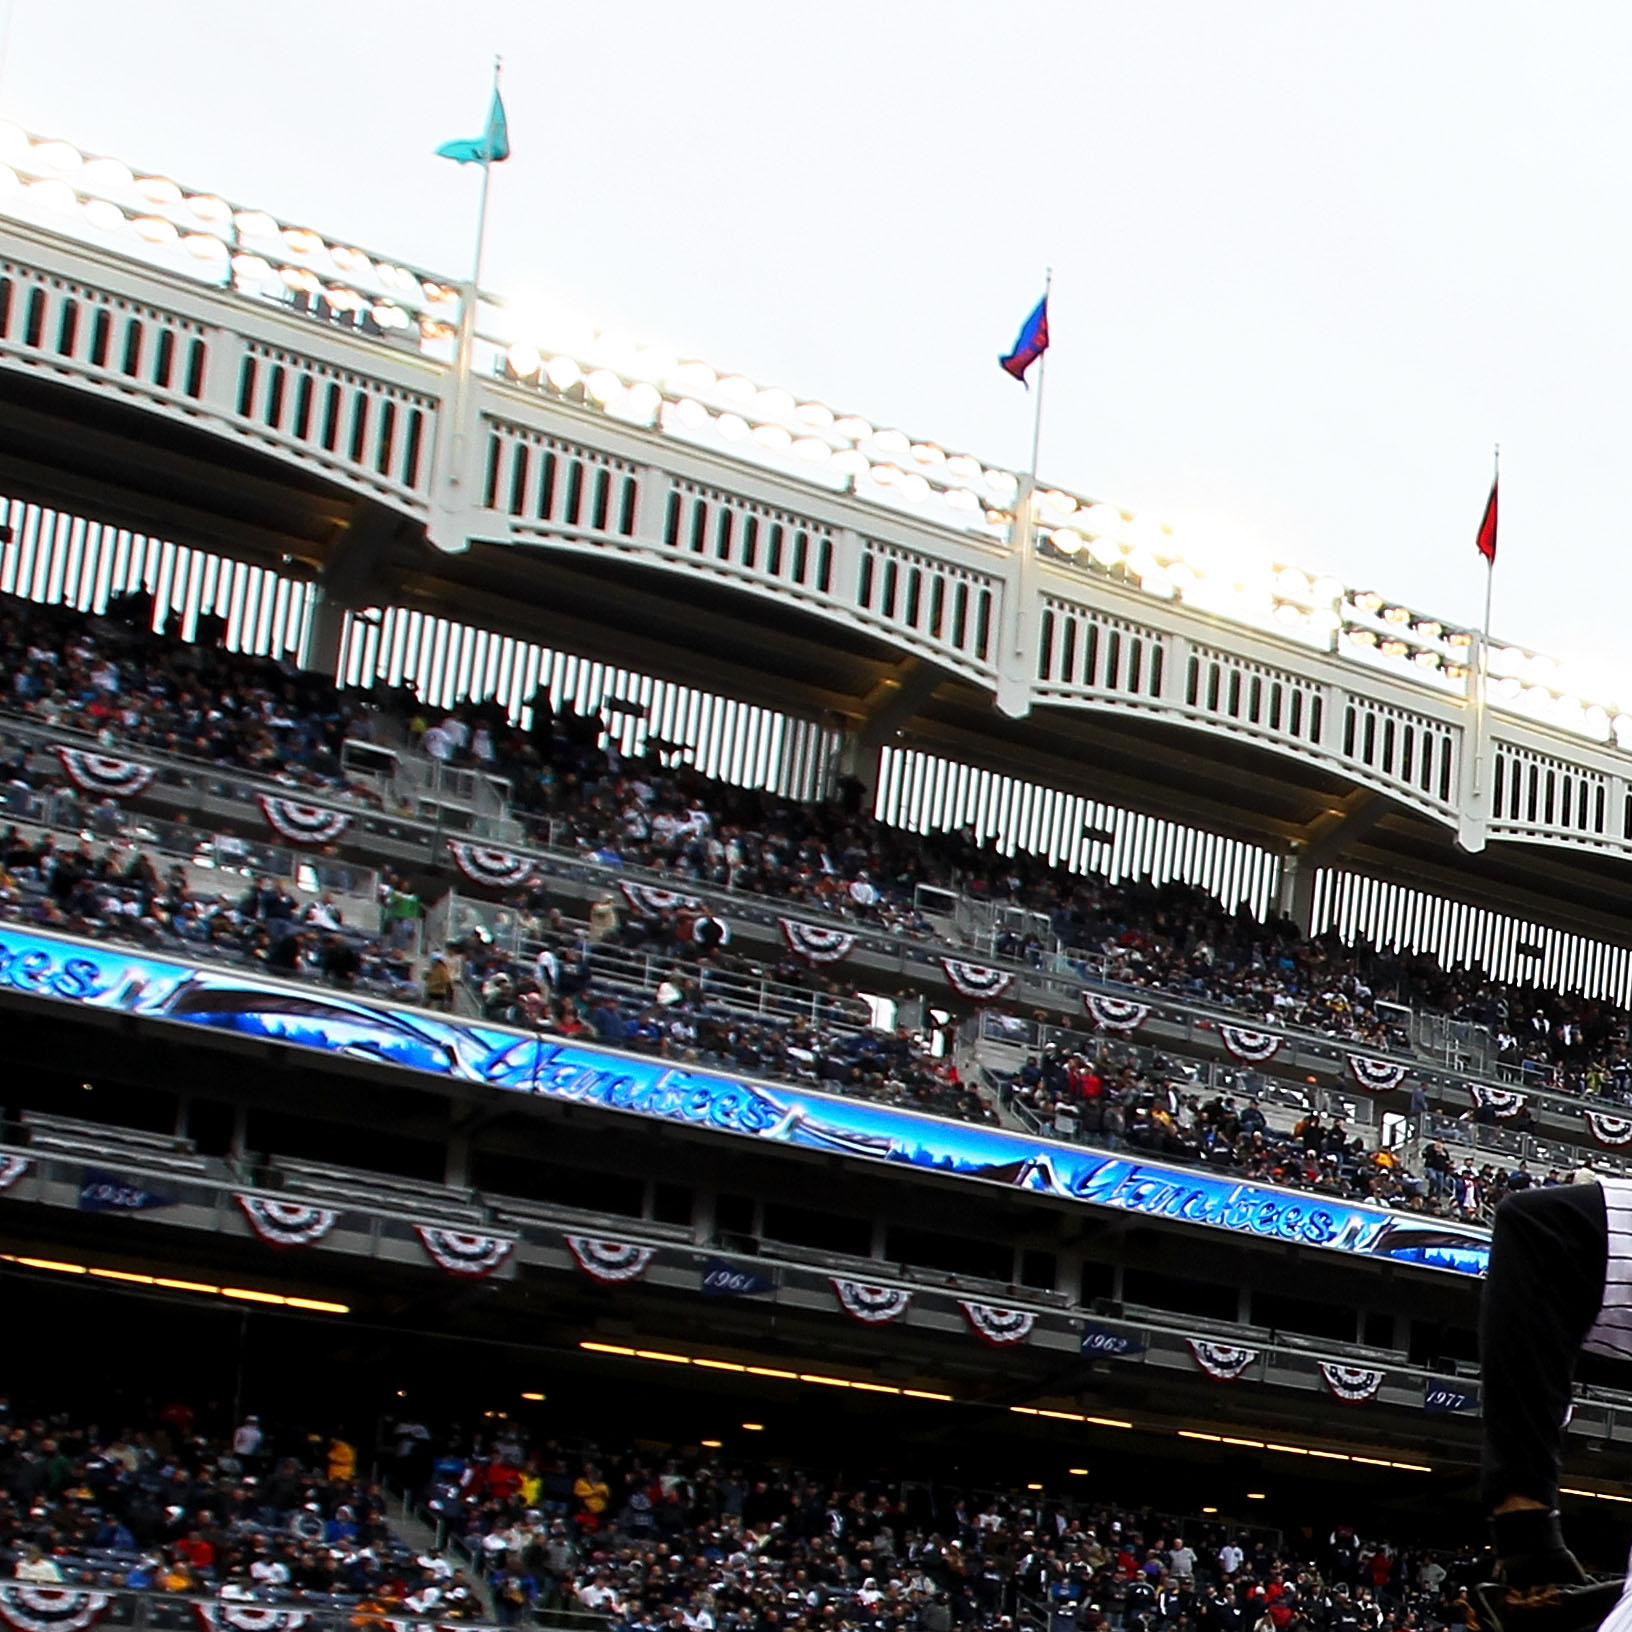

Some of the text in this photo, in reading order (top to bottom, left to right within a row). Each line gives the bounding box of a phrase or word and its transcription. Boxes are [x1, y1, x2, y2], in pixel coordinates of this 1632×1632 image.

[486, 1037, 777, 1132] Yankees
[1073, 1159, 1338, 1243] Yankees
[703, 1271, 755, 1290] 1961
[1082, 1334, 1128, 1353] 1962
[1426, 1391, 1466, 1408] 1977
